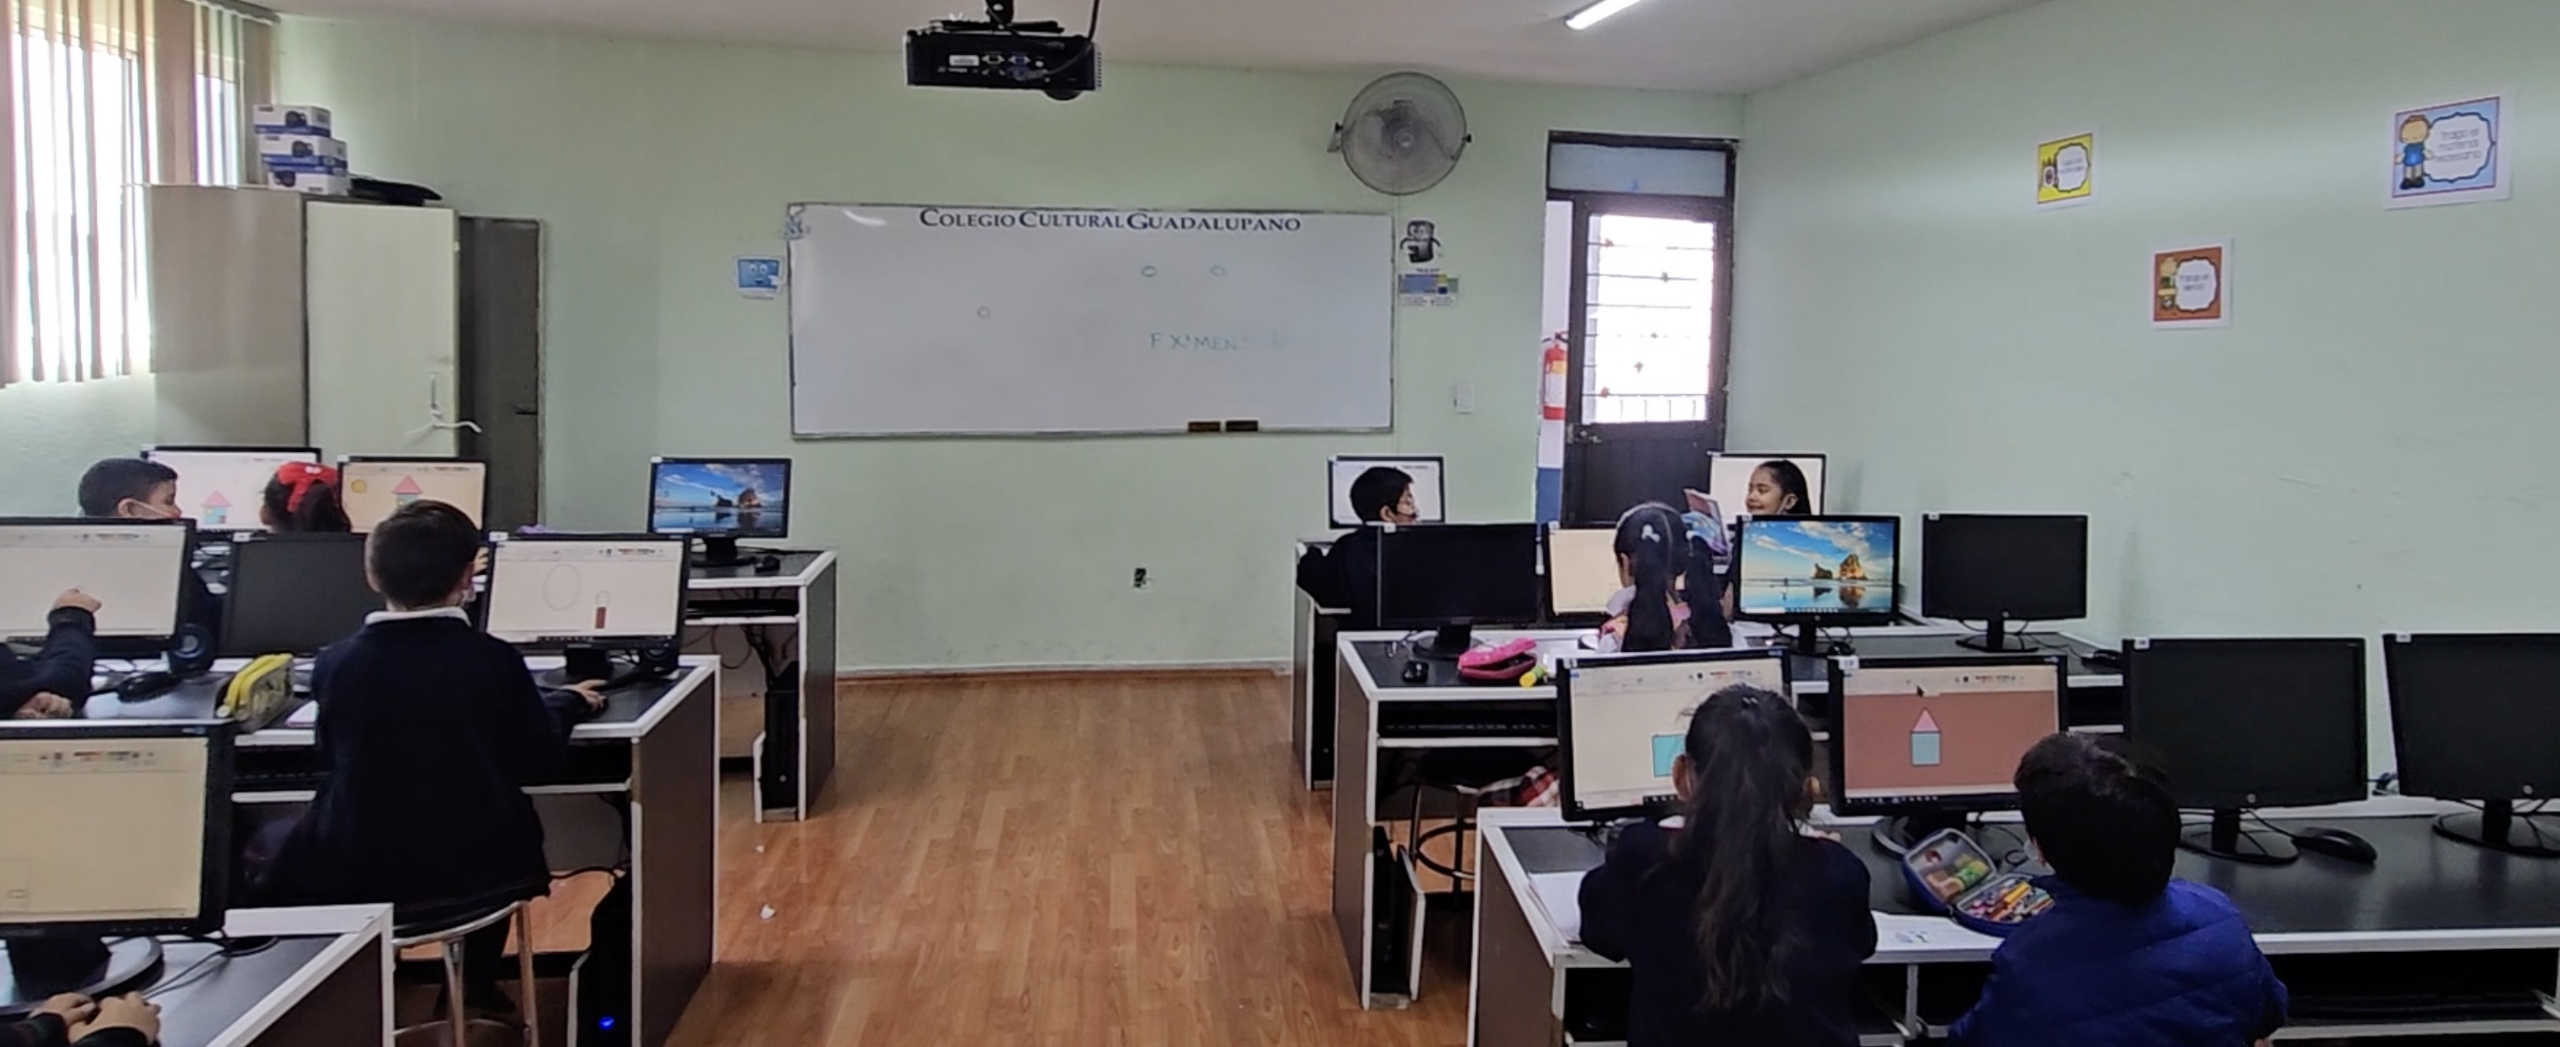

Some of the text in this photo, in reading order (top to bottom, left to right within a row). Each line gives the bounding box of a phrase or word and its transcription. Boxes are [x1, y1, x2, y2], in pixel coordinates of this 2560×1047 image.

[920, 207, 1301, 231] COLEGIO CULTURAL GUADALUPANO
